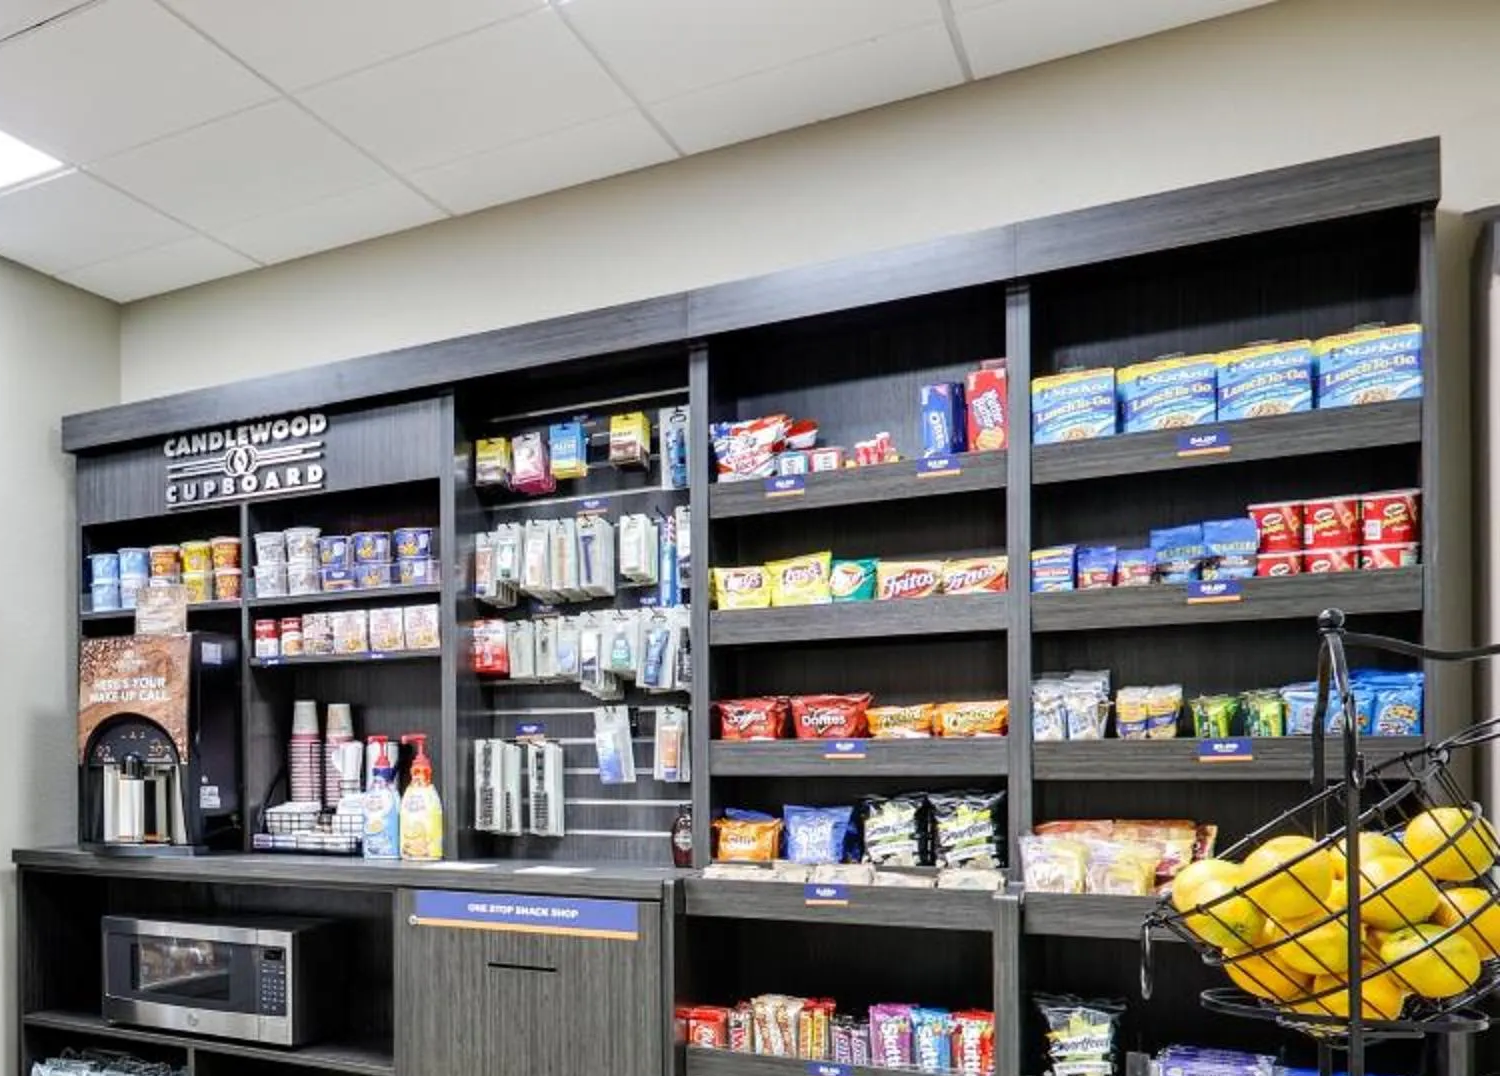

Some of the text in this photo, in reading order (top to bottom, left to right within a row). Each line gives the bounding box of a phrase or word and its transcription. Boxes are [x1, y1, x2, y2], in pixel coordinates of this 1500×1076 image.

[164, 413, 327, 457] CANDLEWOOD
[166, 464, 323, 503] CUPBOARD
[884, 571, 934, 599] Fritos
[802, 714, 846, 728] Doritos
